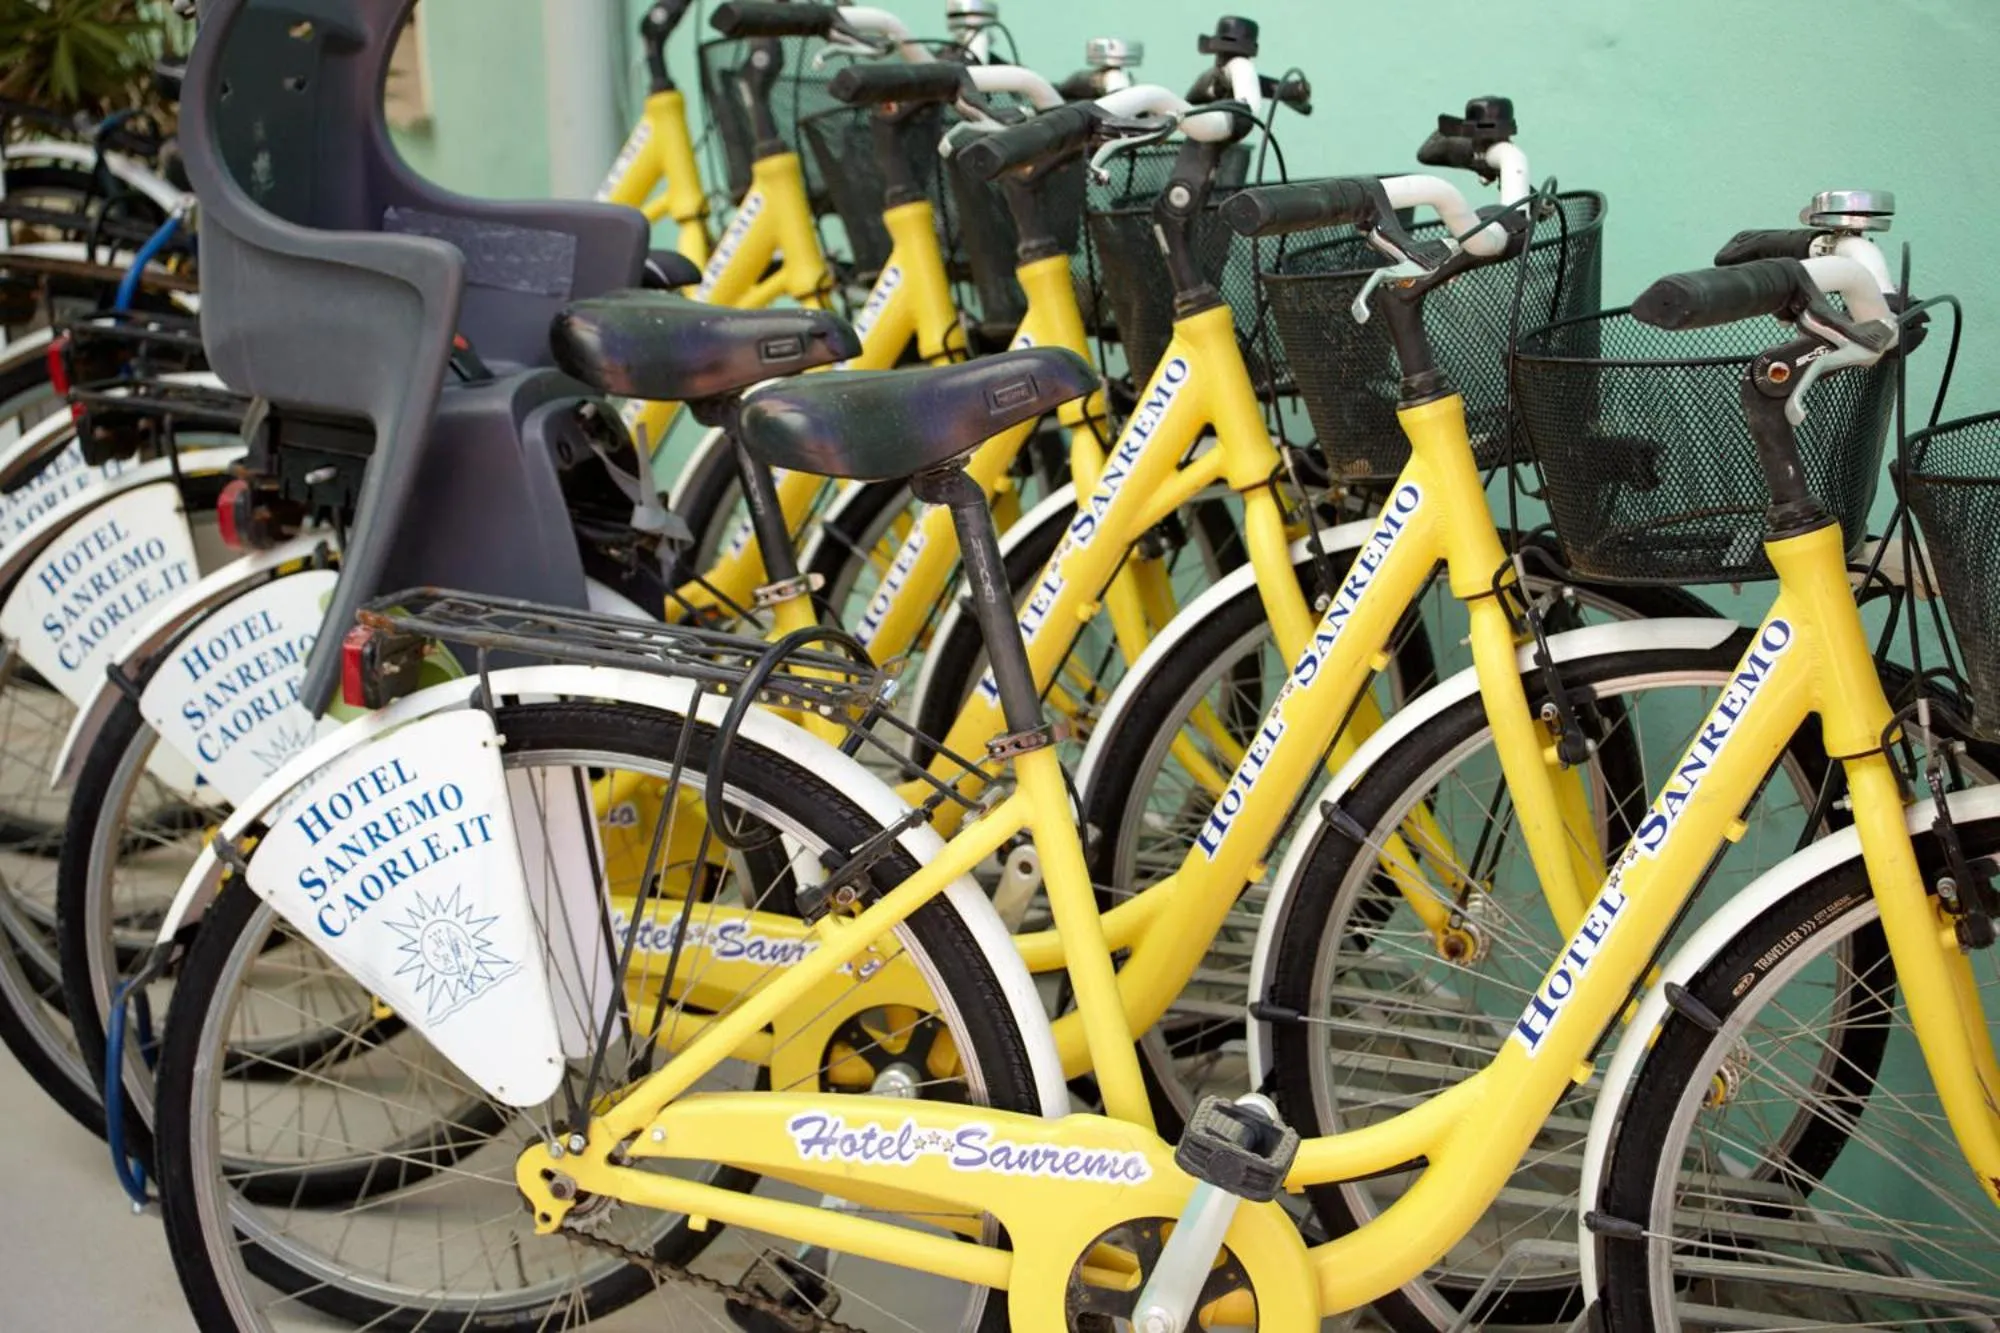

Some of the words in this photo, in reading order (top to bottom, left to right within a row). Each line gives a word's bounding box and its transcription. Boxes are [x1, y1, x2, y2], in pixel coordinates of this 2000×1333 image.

[1071, 357, 1188, 542] SANREMO
[37, 518, 131, 597] HOTEL
[42, 536, 167, 644] SANREMO
[58, 559, 190, 672] CAORLE.IT
[179, 609, 283, 683] HOTEL
[196, 675, 301, 763] CAORLE
[1196, 721, 1285, 860] HOTEL
[1293, 484, 1420, 687] SANREMO
[293, 756, 418, 846] HOTEL
[297, 782, 464, 903] SANREMO
[1515, 888, 1626, 1051] HOTEL
[1636, 617, 1793, 853] SANREMO
[317, 813, 494, 939] CAORLE.IT
[613, 914, 684, 950] otel
[1754, 929, 1802, 972] TRAVELLER
[791, 1115, 915, 1162] Hotel
[953, 1127, 1146, 1181] Sanremo
